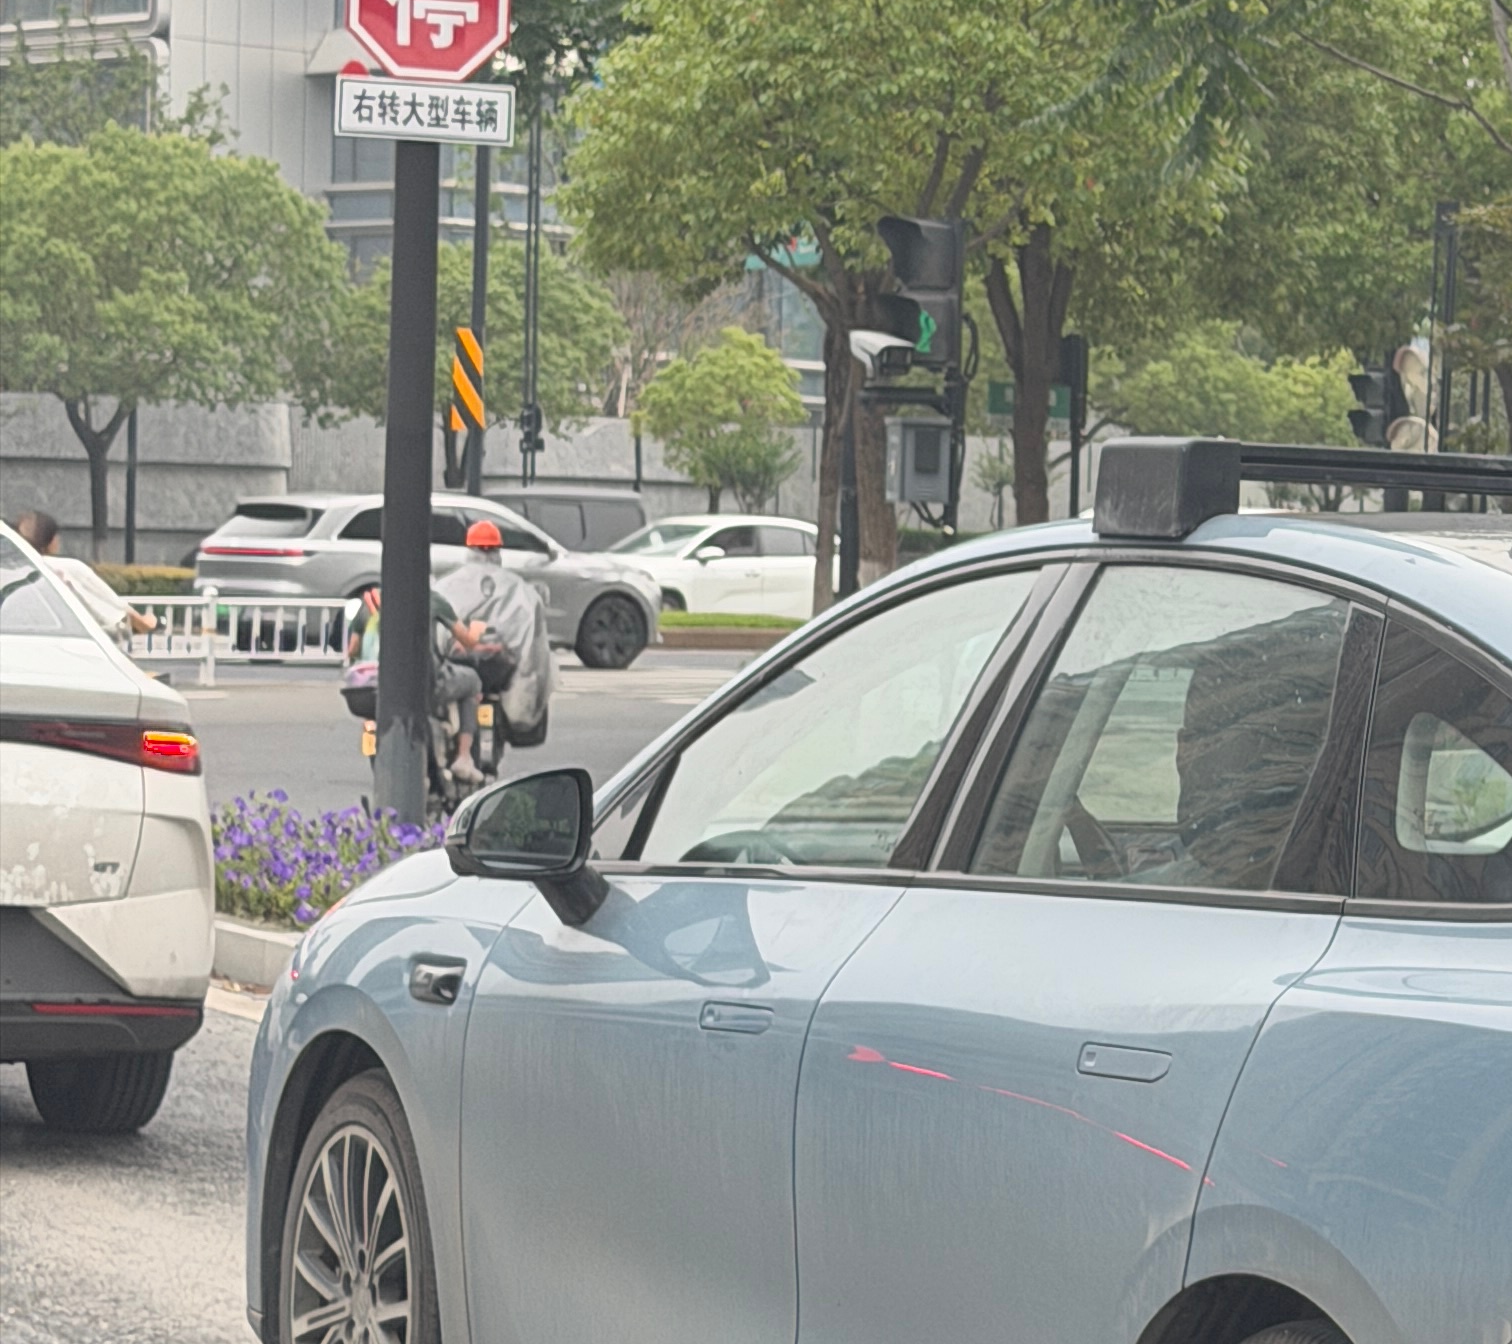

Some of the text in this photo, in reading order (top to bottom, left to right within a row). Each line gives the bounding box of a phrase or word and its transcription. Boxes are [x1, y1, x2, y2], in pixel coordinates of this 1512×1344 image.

[352, 88, 499, 133] 右转大型车辆
